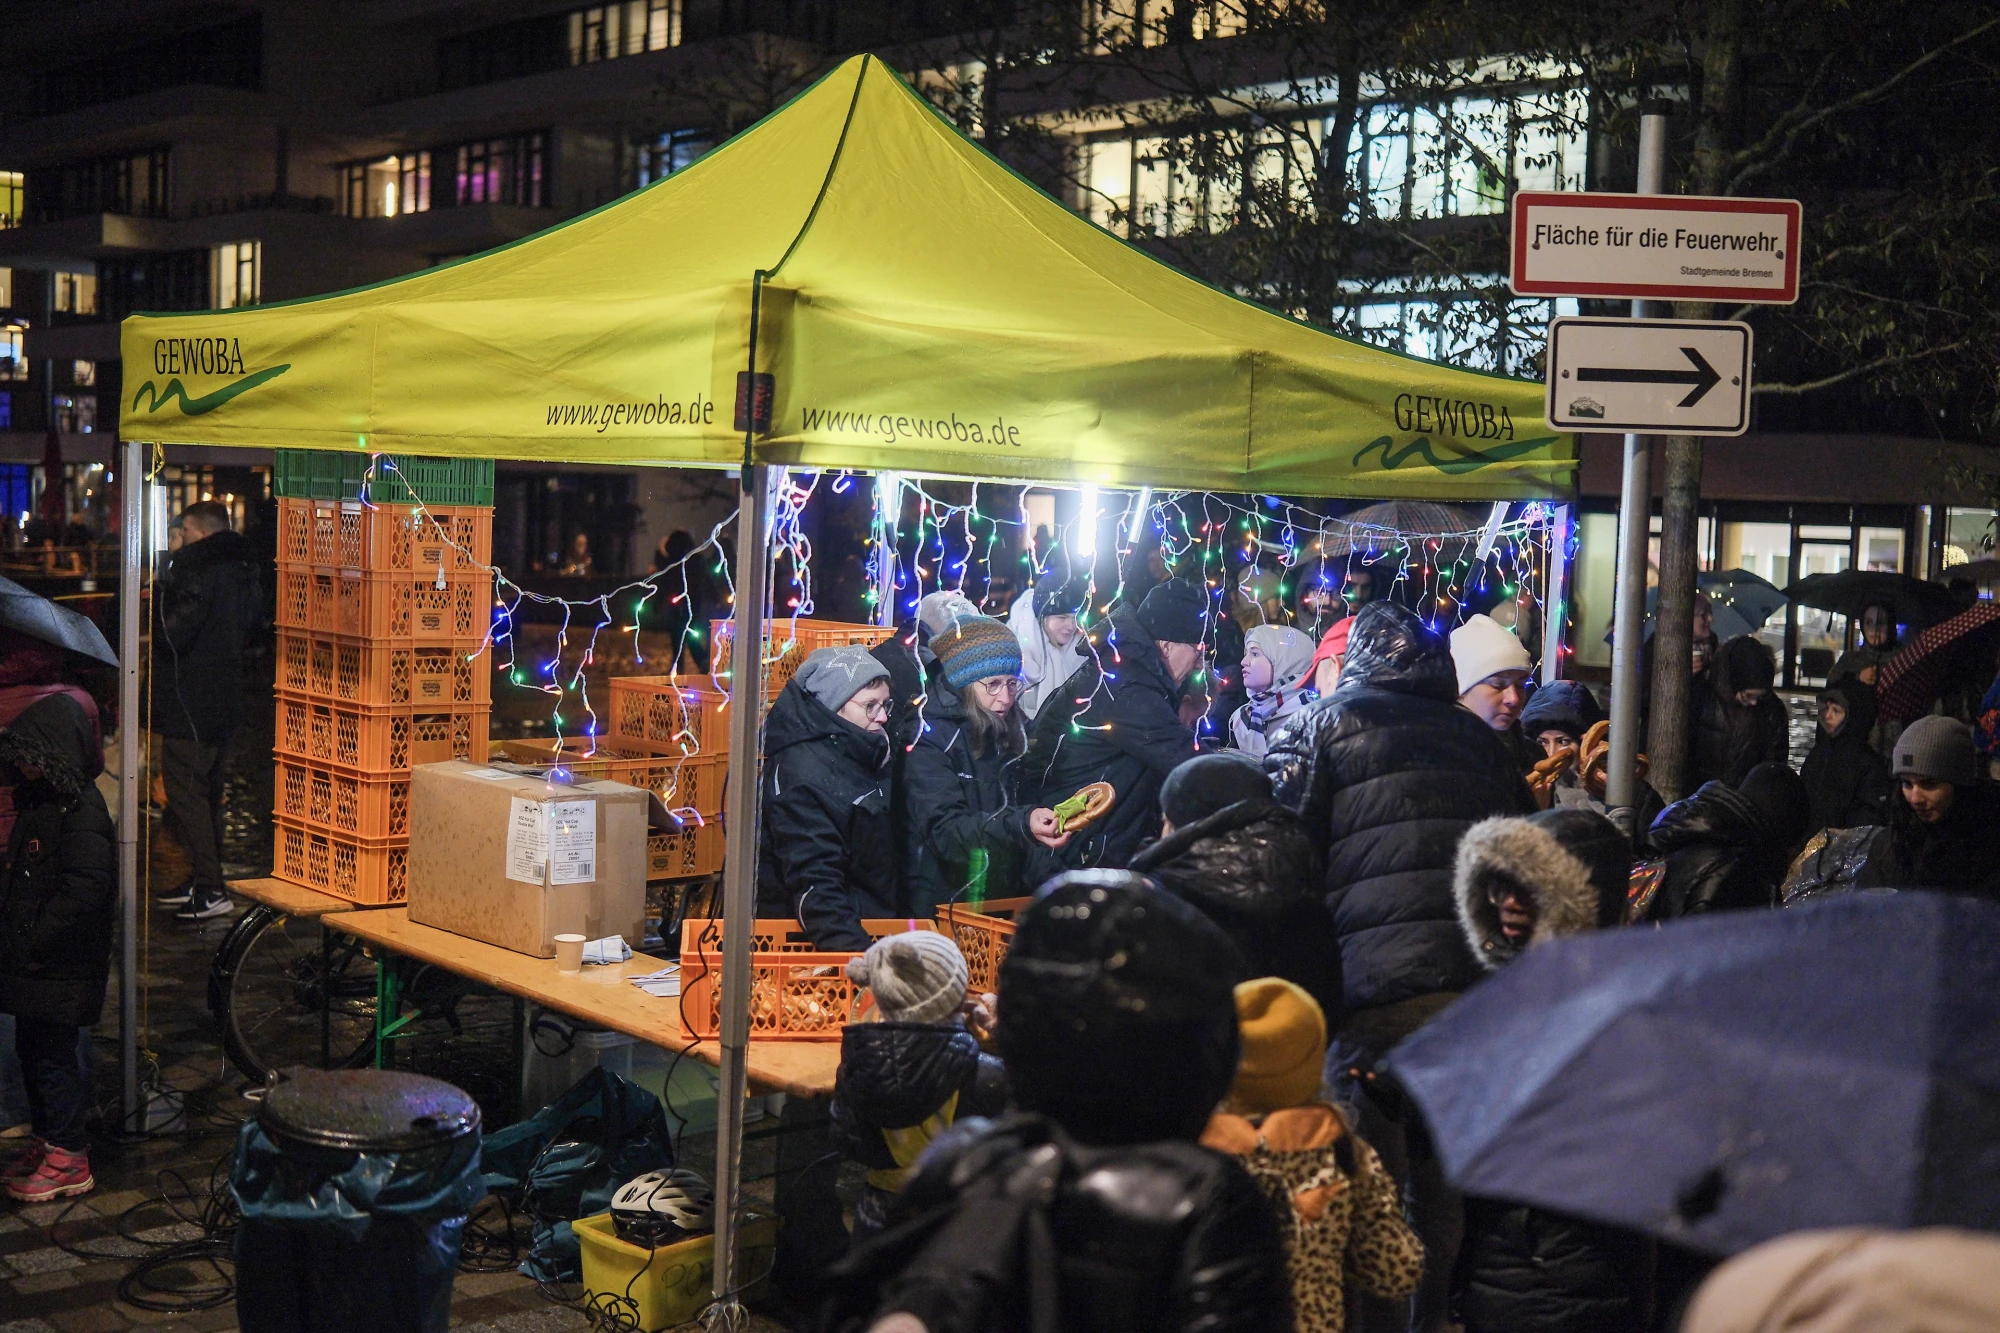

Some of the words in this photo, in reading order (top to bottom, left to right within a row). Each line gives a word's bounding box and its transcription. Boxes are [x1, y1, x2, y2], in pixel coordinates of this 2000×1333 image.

[1535, 224, 1599, 245] Fläche
[1606, 227, 1633, 247] für
[1639, 228, 1668, 248] die
[1675, 229, 1778, 252] Feuerwehr
[1680, 266, 1740, 278] Stadtgemeinde
[1742, 268, 1773, 278] Bremen
[154, 337, 246, 375] GEWOBA
[546, 392, 714, 433] www.gewoba.de
[802, 407, 1021, 446] www.gewoba.de
[1394, 393, 1514, 440] GEWOBA
